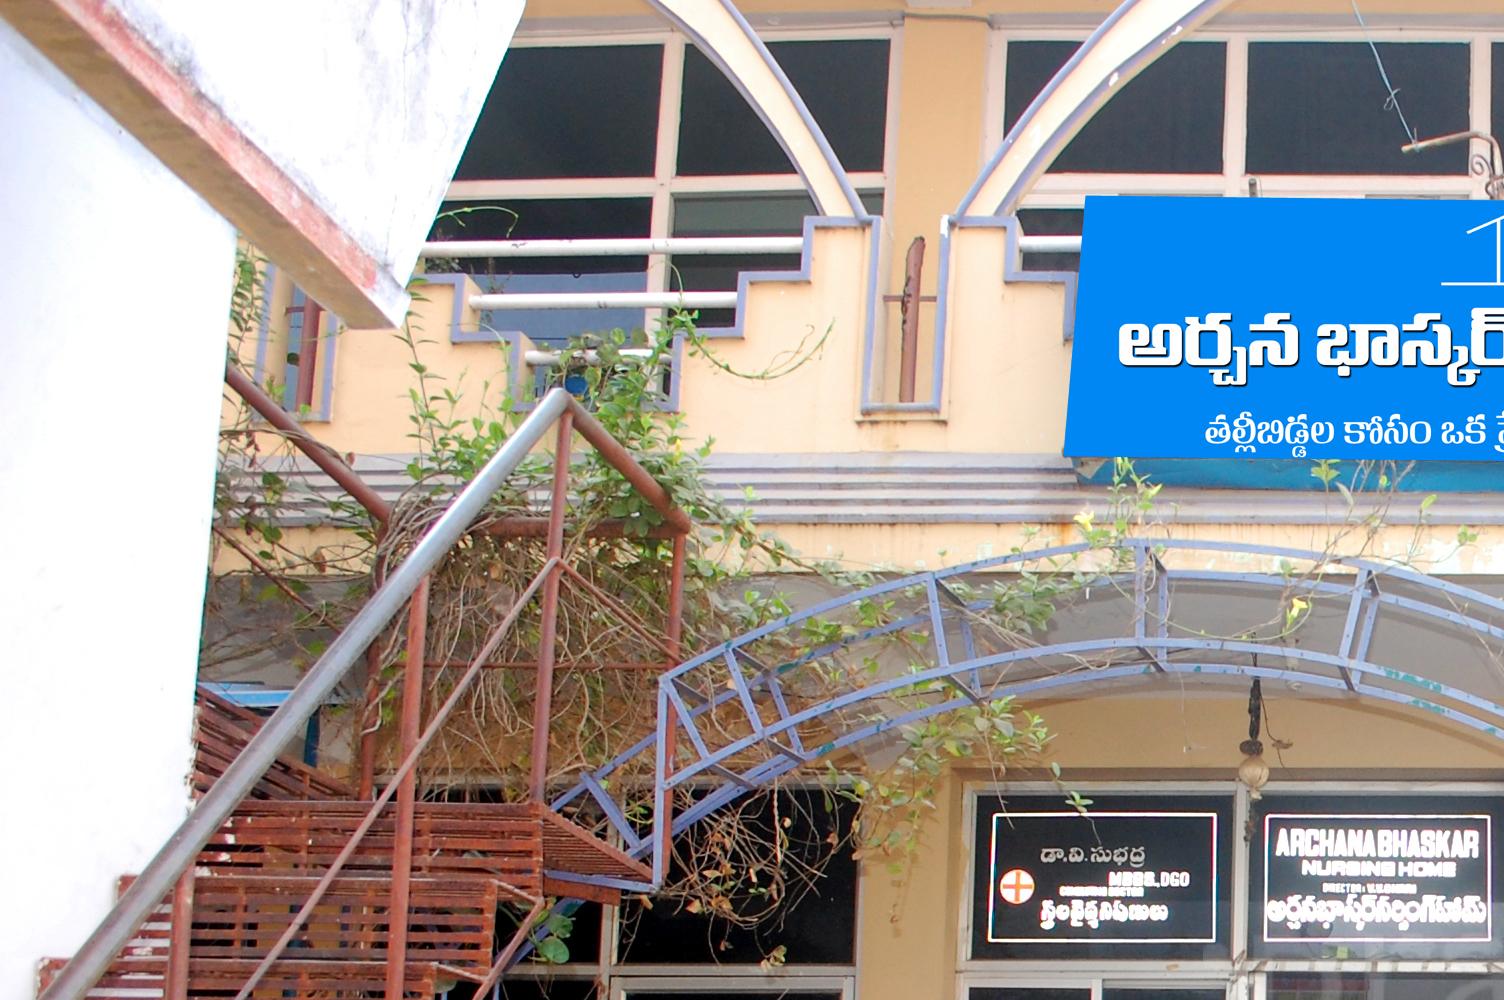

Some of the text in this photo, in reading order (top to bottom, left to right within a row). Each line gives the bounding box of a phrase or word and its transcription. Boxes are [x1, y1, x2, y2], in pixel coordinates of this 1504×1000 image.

[1117, 311, 1300, 387] అర్చన
[1343, 412, 1433, 446] కోసం
[1441, 413, 1487, 446] ఒక
[1275, 828, 1480, 858] ARCHANA BHASKAR
